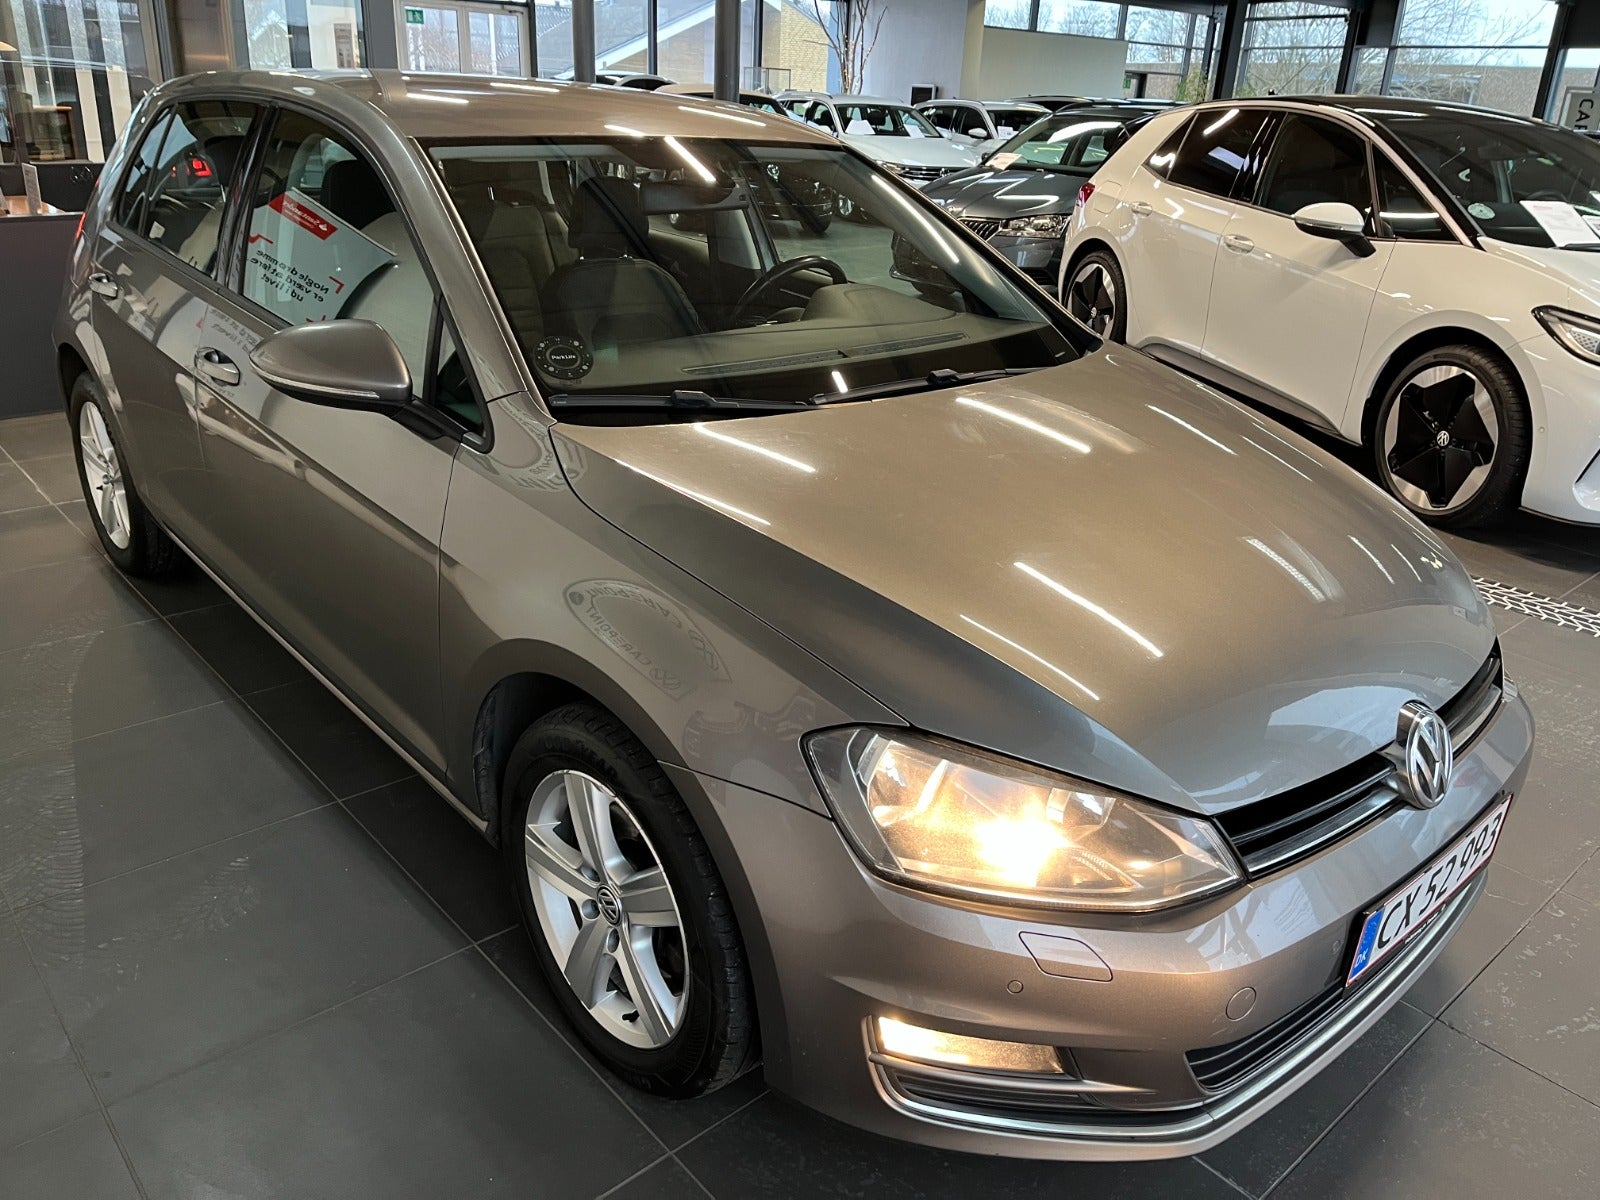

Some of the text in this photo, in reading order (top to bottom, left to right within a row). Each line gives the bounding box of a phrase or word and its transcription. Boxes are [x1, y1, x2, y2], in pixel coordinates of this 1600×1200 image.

[1377, 883, 1423, 950] CX
[1418, 854, 1458, 917] 52
[1456, 811, 1503, 883] 993
[1354, 948, 1369, 968] DK
